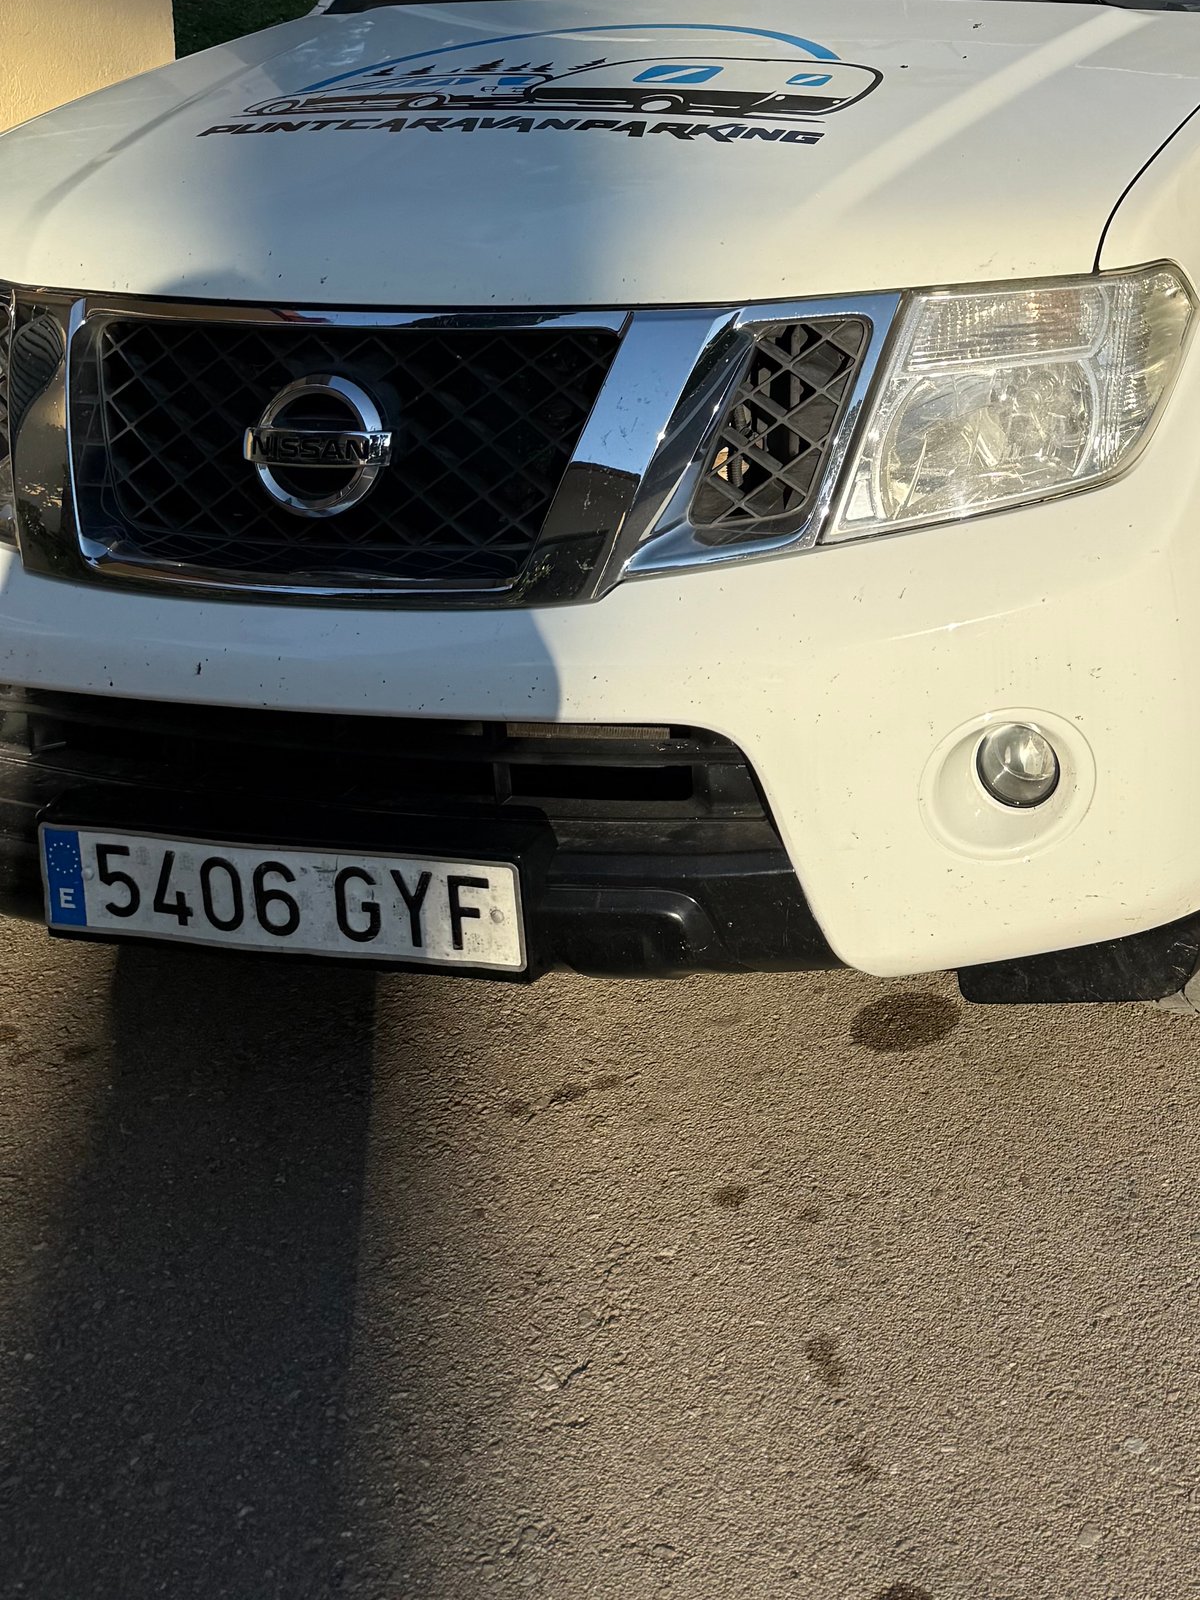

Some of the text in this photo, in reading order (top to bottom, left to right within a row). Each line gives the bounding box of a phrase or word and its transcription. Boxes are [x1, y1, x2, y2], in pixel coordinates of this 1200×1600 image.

[196, 115, 825, 145] PUNTCARAVANPARKING
[252, 434, 370, 461] NISSAN
[59, 887, 77, 909] E
[96, 843, 490, 950] 5406 GYF
